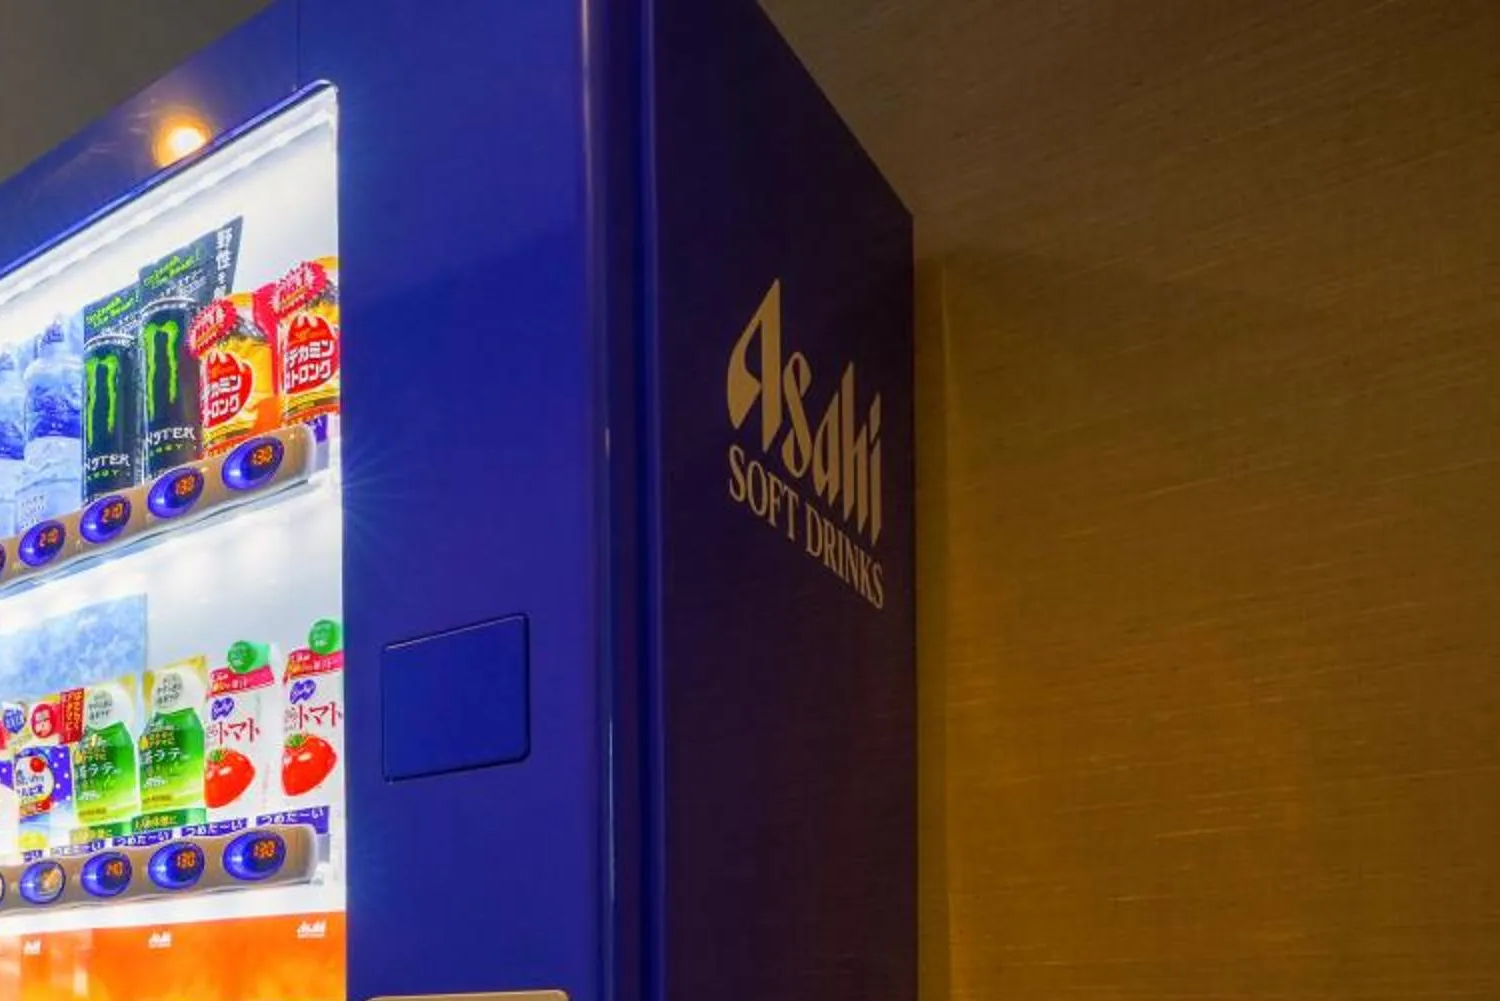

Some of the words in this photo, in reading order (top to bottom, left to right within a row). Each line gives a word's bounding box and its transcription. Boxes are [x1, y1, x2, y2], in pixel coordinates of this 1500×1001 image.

[726, 277, 882, 547] Asahi
[729, 444, 800, 542] SOFT
[804, 502, 885, 610] DRINKS
[218, 717, 261, 745] トマト
[299, 701, 343, 729] トマト
